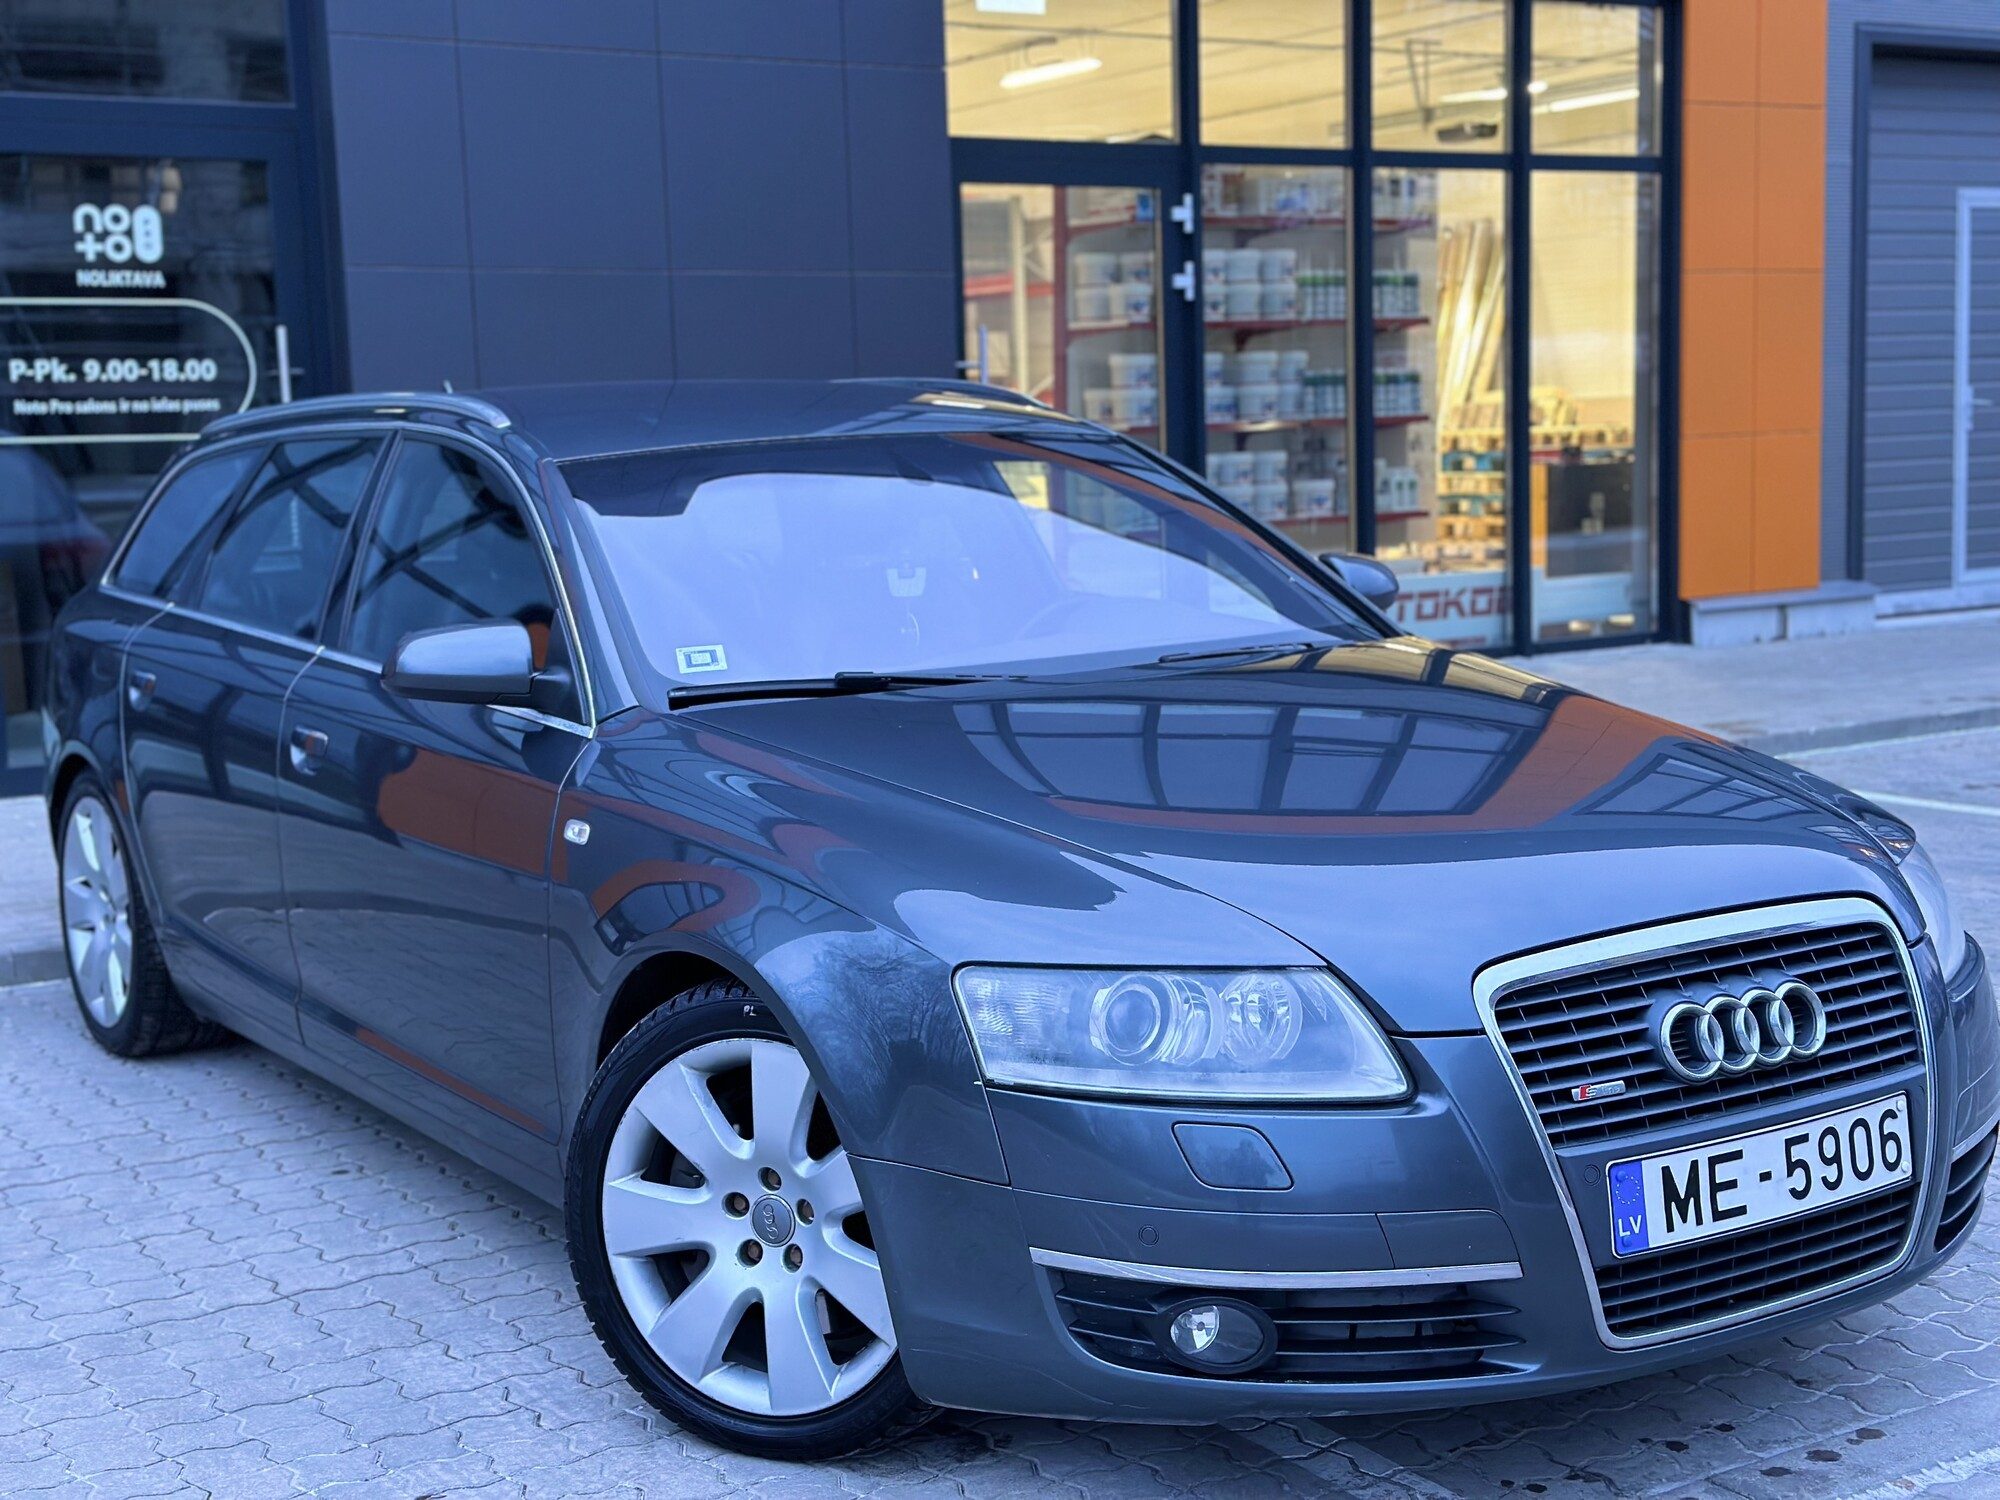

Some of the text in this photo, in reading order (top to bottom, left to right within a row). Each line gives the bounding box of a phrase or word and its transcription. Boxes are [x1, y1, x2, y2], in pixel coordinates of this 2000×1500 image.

[76, 268, 166, 288] NOLIKTAVA
[9, 358, 217, 382] P-Pk. 9.00-18.00
[1660, 1108, 1903, 1234] ME-5906
[1617, 1214, 1643, 1238] LV
